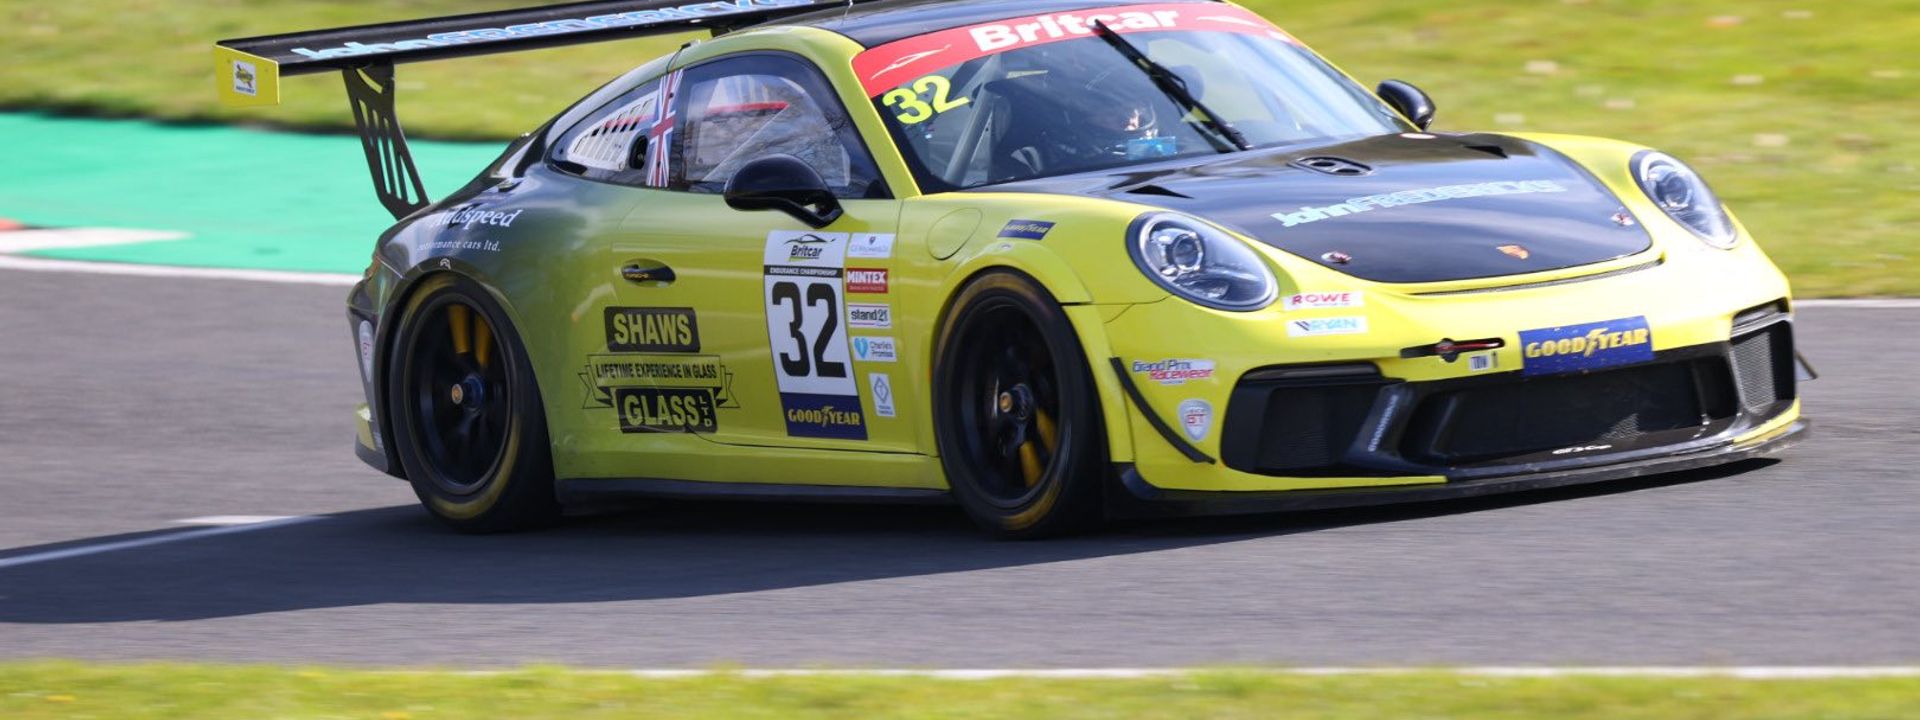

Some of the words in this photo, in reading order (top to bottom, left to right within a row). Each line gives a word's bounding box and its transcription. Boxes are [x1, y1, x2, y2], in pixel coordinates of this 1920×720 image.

[968, 8, 1180, 52] Britcar
[882, 75, 970, 125] 32
[790, 245, 823, 258] Britcar
[847, 271, 886, 284] MINTEX
[1291, 292, 1351, 306] ROWE
[613, 313, 692, 346] SHAWS
[771, 281, 847, 378] 32
[1525, 327, 1649, 358] GOODYEAR
[595, 363, 633, 379] LIFETIME
[634, 363, 682, 379] EXPERIENCE
[683, 363, 692, 379] IN
[692, 363, 718, 379] GLASS
[623, 394, 701, 427] GLASS
[698, 395, 713, 428] LTD
[787, 405, 861, 428] GOODYEAR
